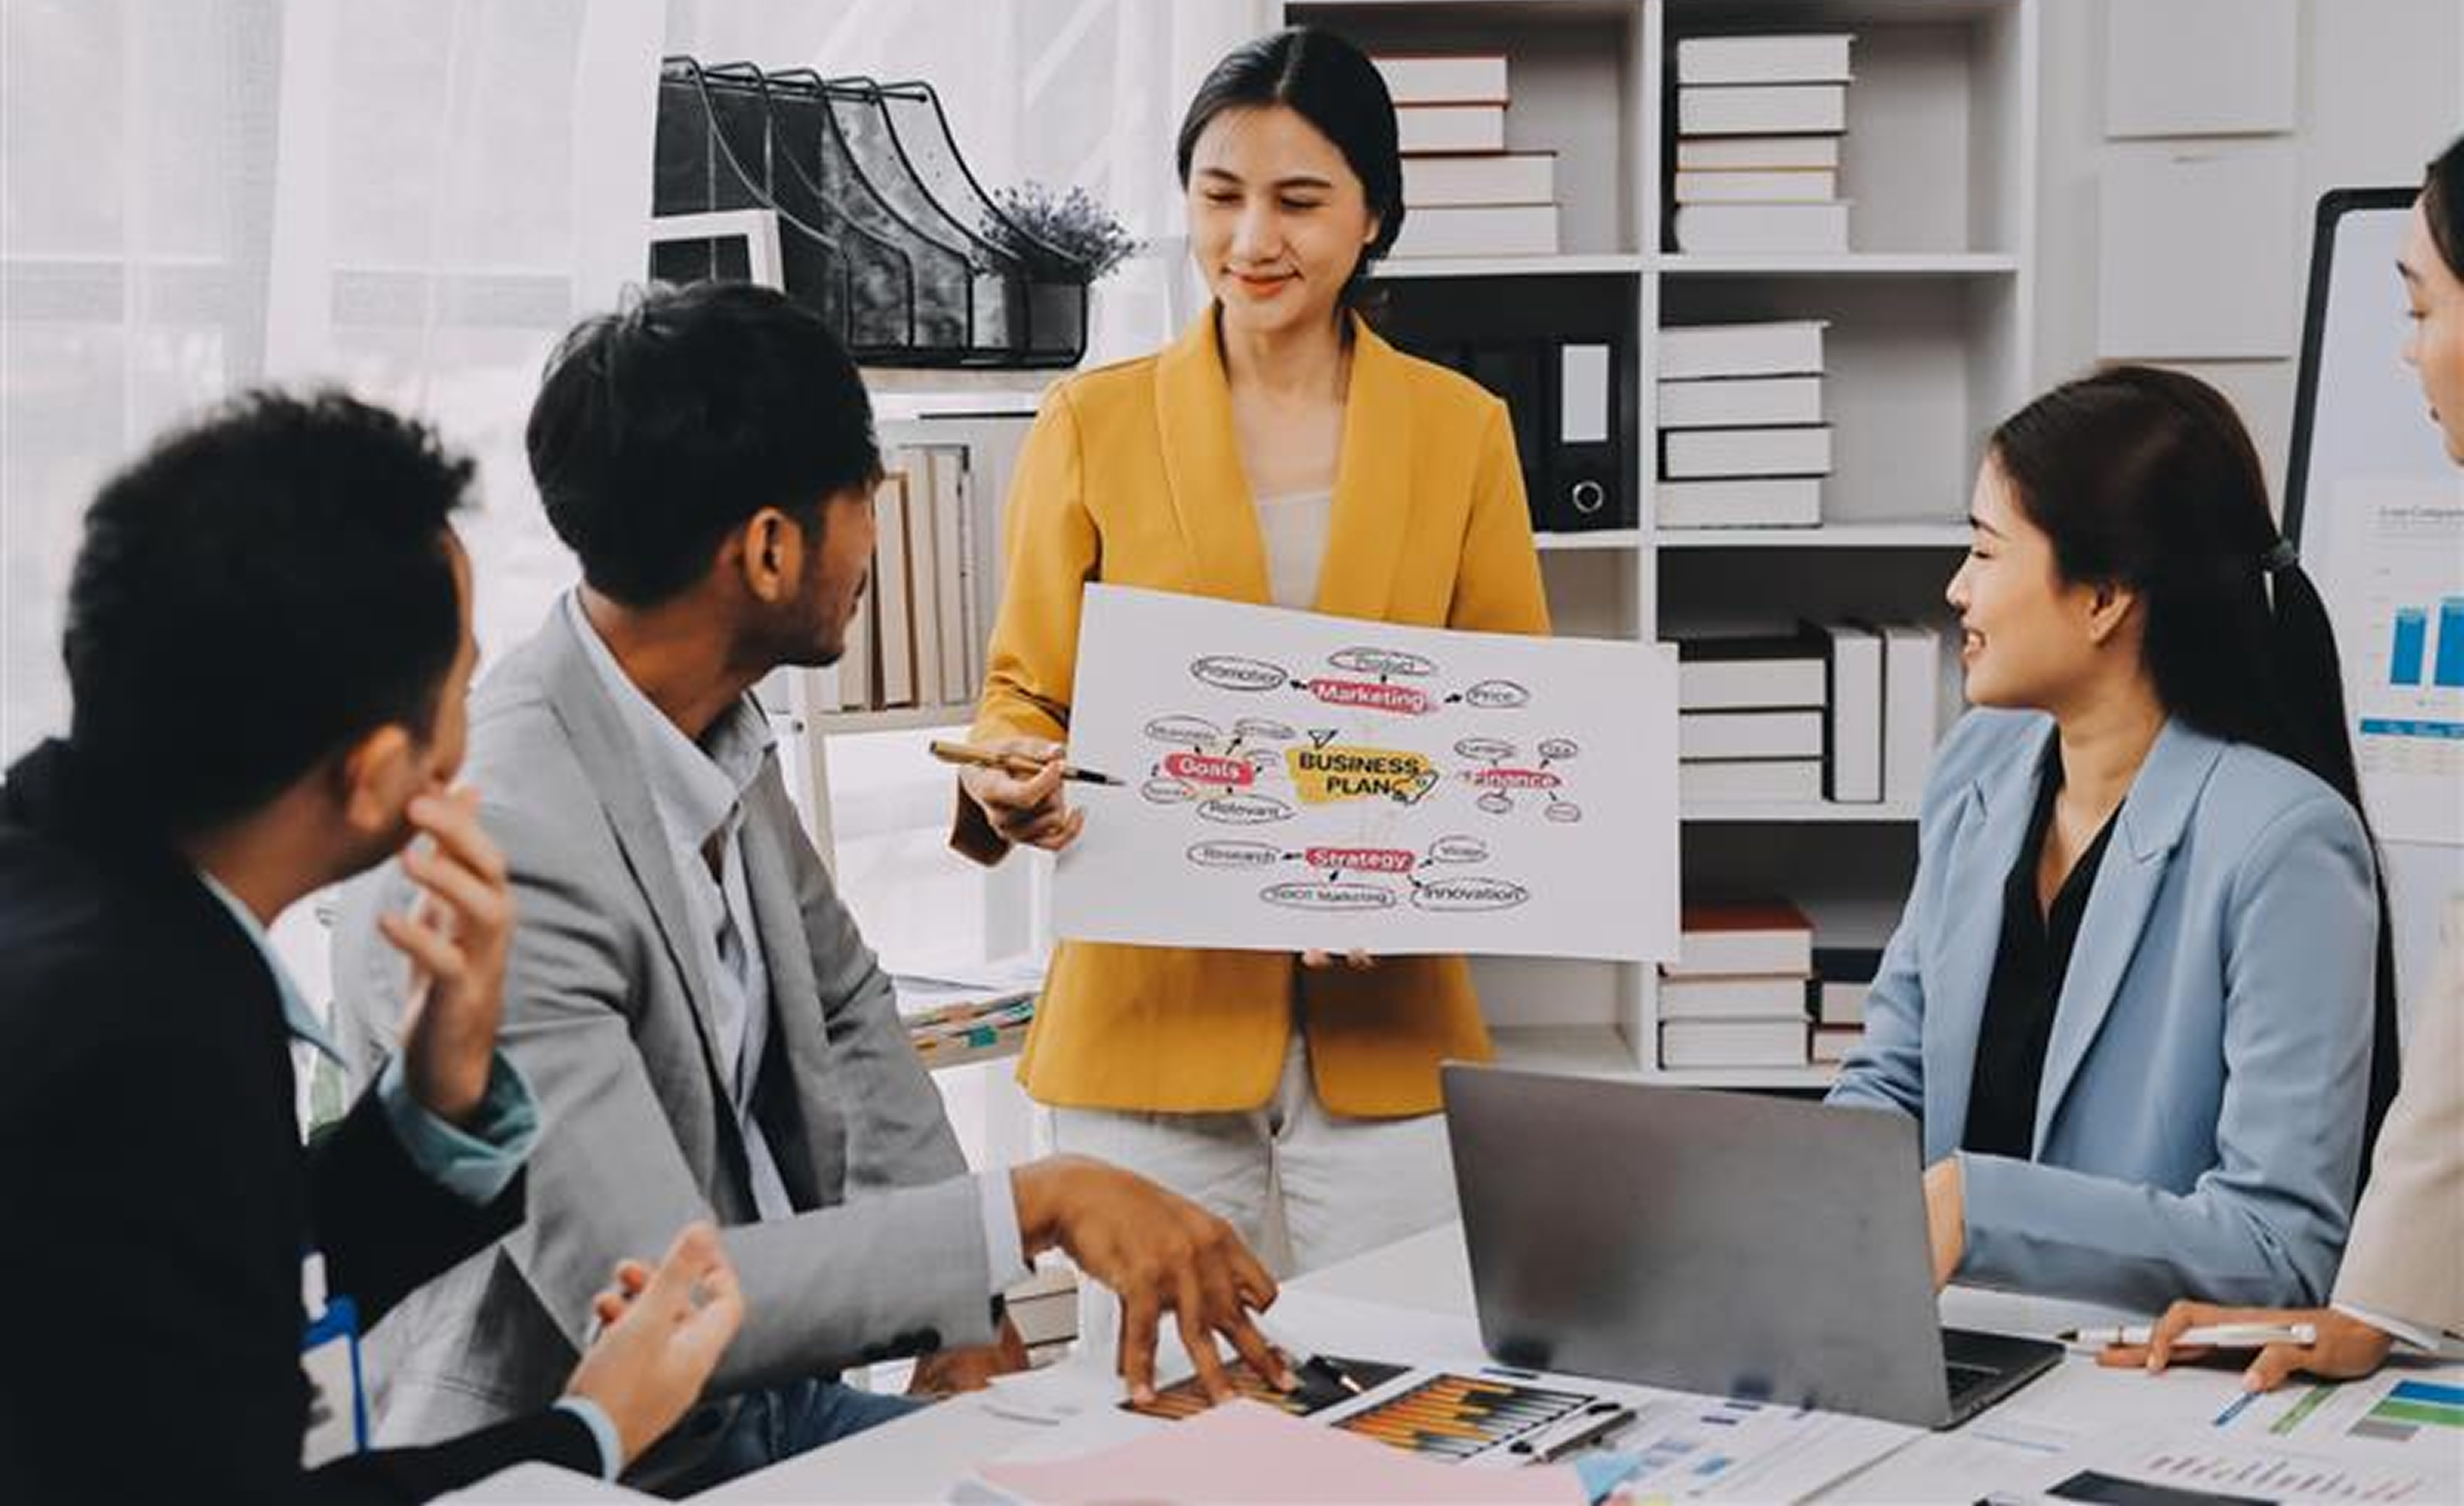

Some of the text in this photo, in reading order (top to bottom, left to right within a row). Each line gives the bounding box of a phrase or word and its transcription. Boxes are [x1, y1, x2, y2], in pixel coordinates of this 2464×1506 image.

[1317, 683, 1425, 711] Marketing
[1179, 757, 1241, 779] Goals
[1299, 751, 1420, 775] BUSINESS
[1326, 777, 1391, 795] PLAN
[1313, 848, 1408, 871] Strategy
[1425, 885, 1522, 901] Innovation
